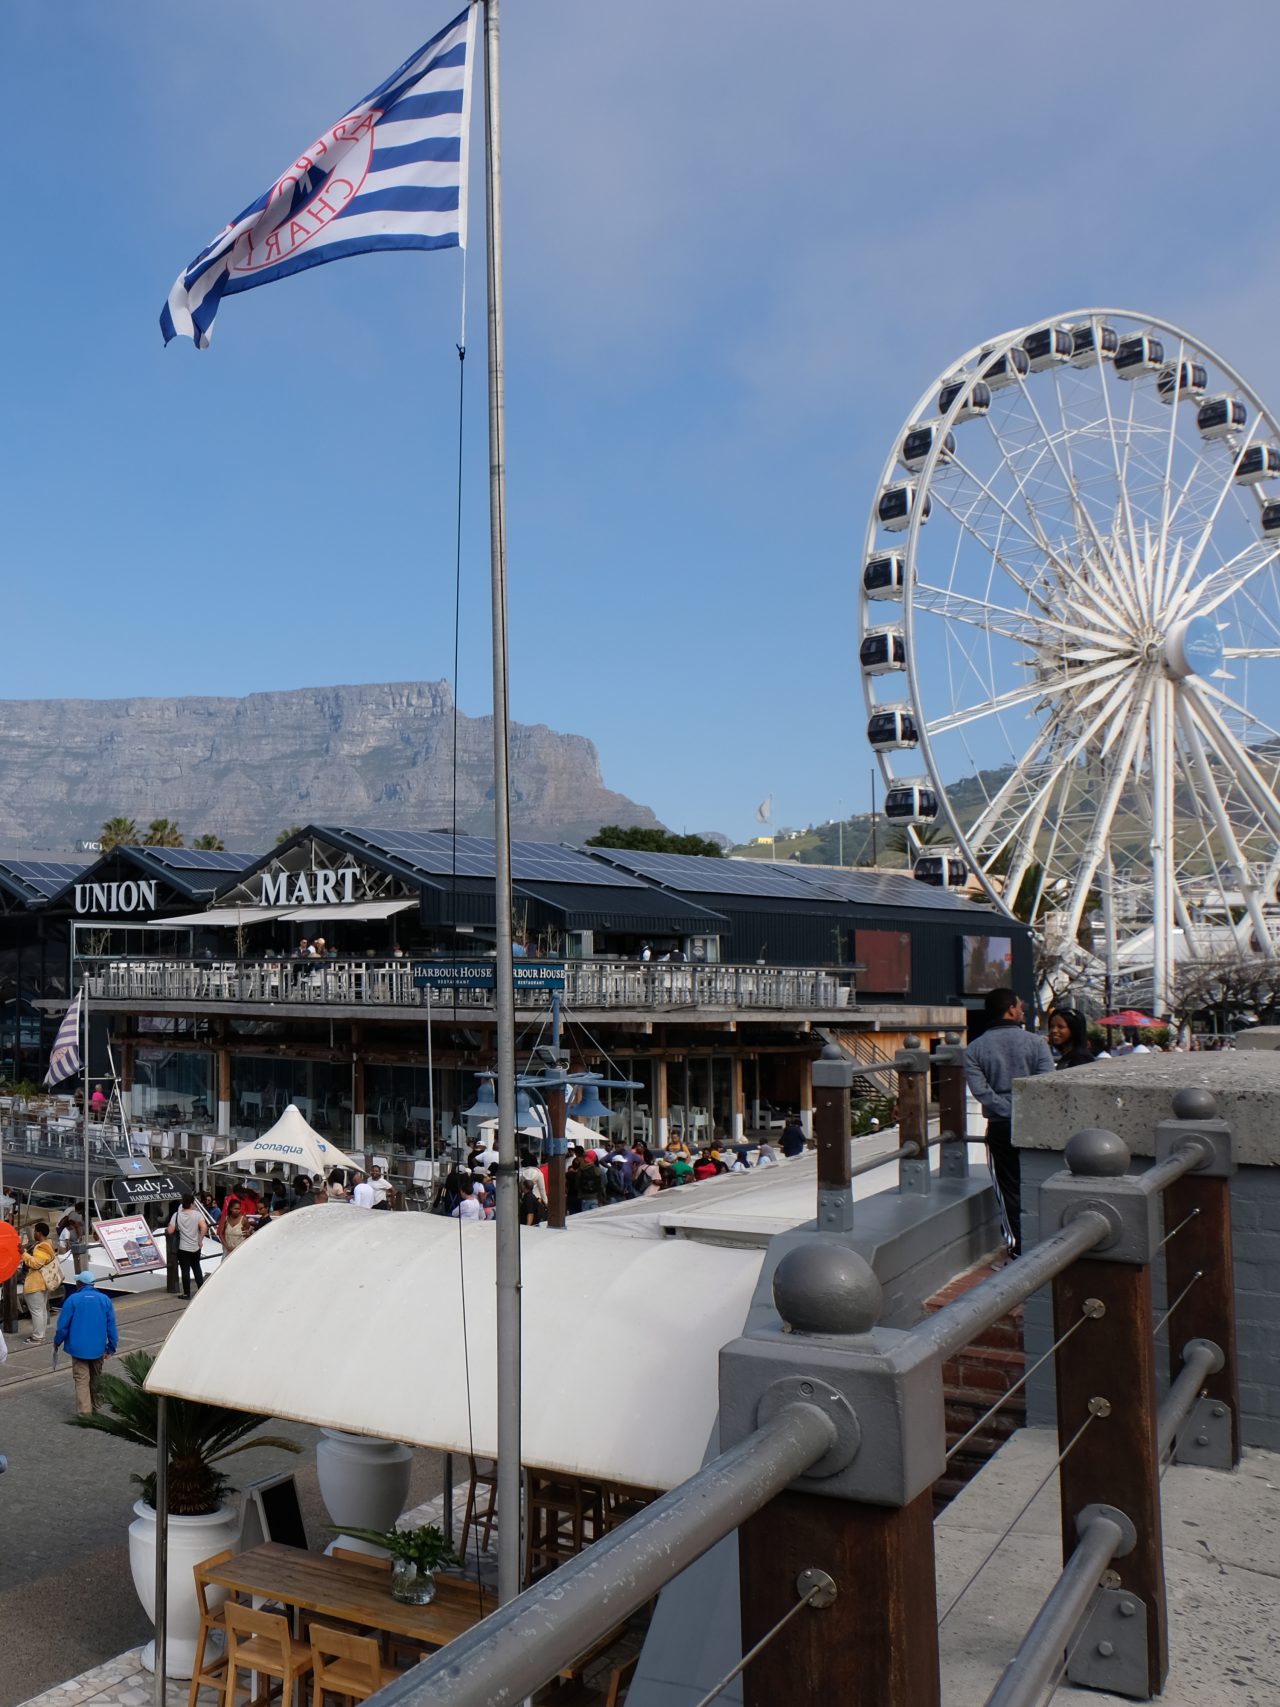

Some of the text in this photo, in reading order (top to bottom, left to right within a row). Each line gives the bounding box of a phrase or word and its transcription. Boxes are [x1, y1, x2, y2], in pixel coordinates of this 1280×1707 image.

[259, 868, 360, 906] MART
[74, 880, 157, 913] UNION
[414, 966, 492, 978] HARBOUR HOUSE
[513, 967, 565, 979] RBOUR HOUSE
[253, 1142, 304, 1155] bonaqua
[122, 1178, 174, 1194] Lady-J
[129, 1192, 181, 1202] HARBOUR TOURS
